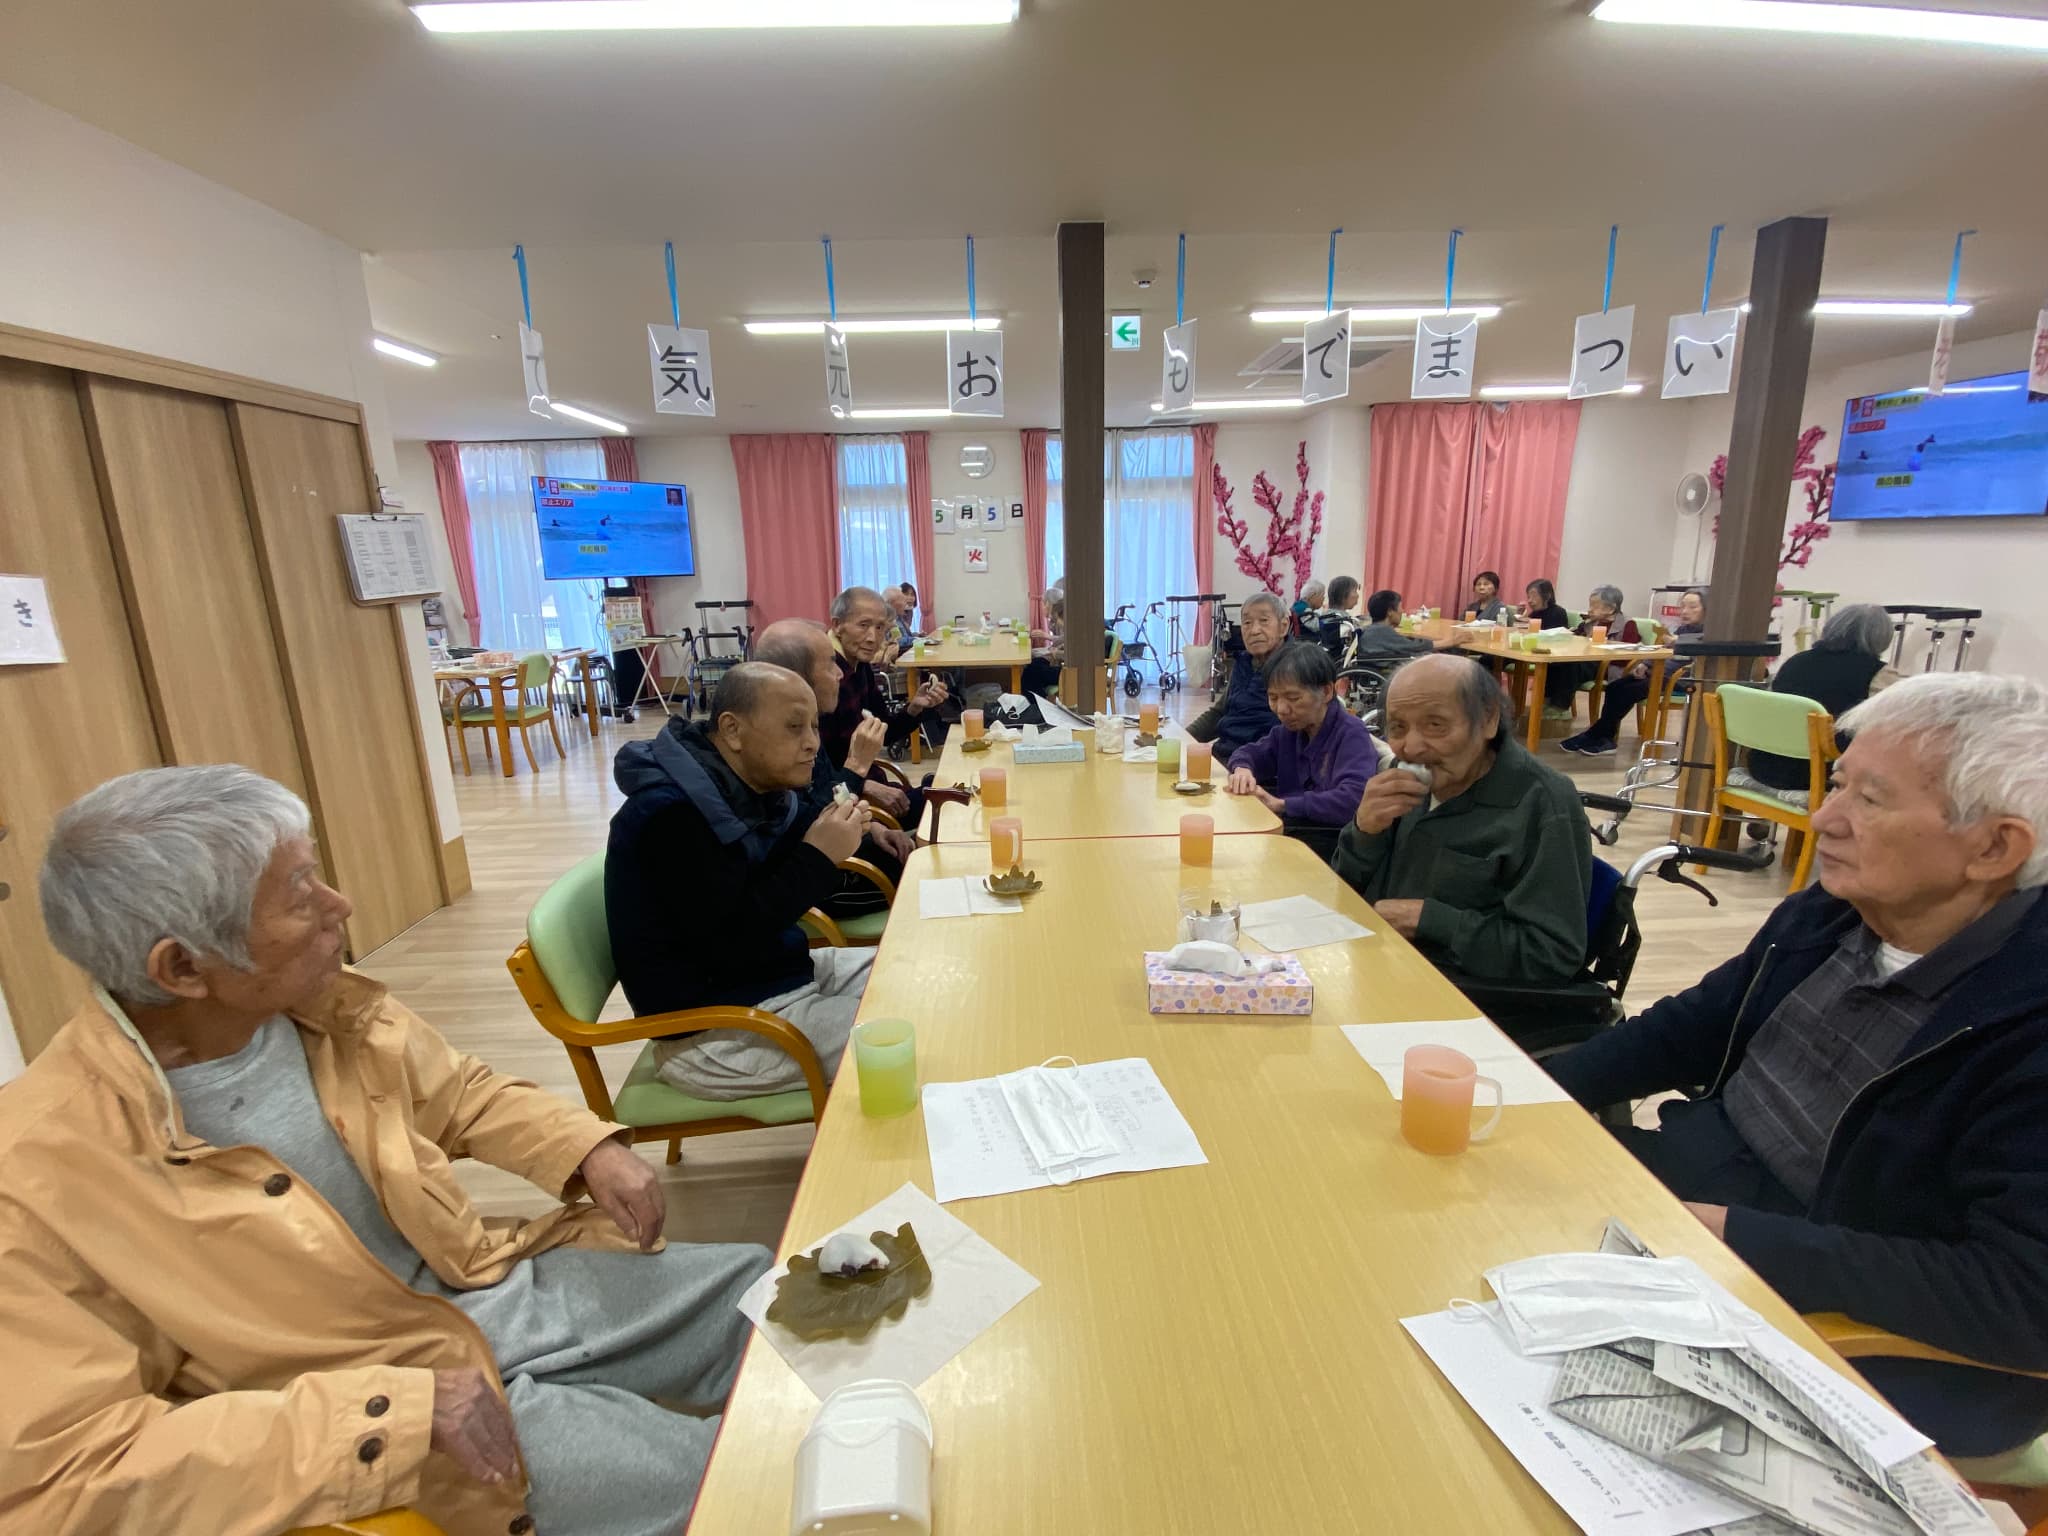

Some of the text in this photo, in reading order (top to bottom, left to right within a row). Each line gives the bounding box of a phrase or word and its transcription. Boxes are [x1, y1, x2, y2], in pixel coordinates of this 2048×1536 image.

[660, 345, 710, 401] 気
[829, 350, 849, 399] 元
[957, 350, 997, 397] お
[1168, 346, 1189, 393] も
[1308, 327, 1347, 379] で
[1427, 332, 1461, 378] ま
[1580, 339, 1624, 372] つ
[1675, 340, 1724, 377] い
[935, 503, 1024, 523] 5 月 5 日
[969, 548, 983, 563] 火
[13, 598, 33, 628] き
